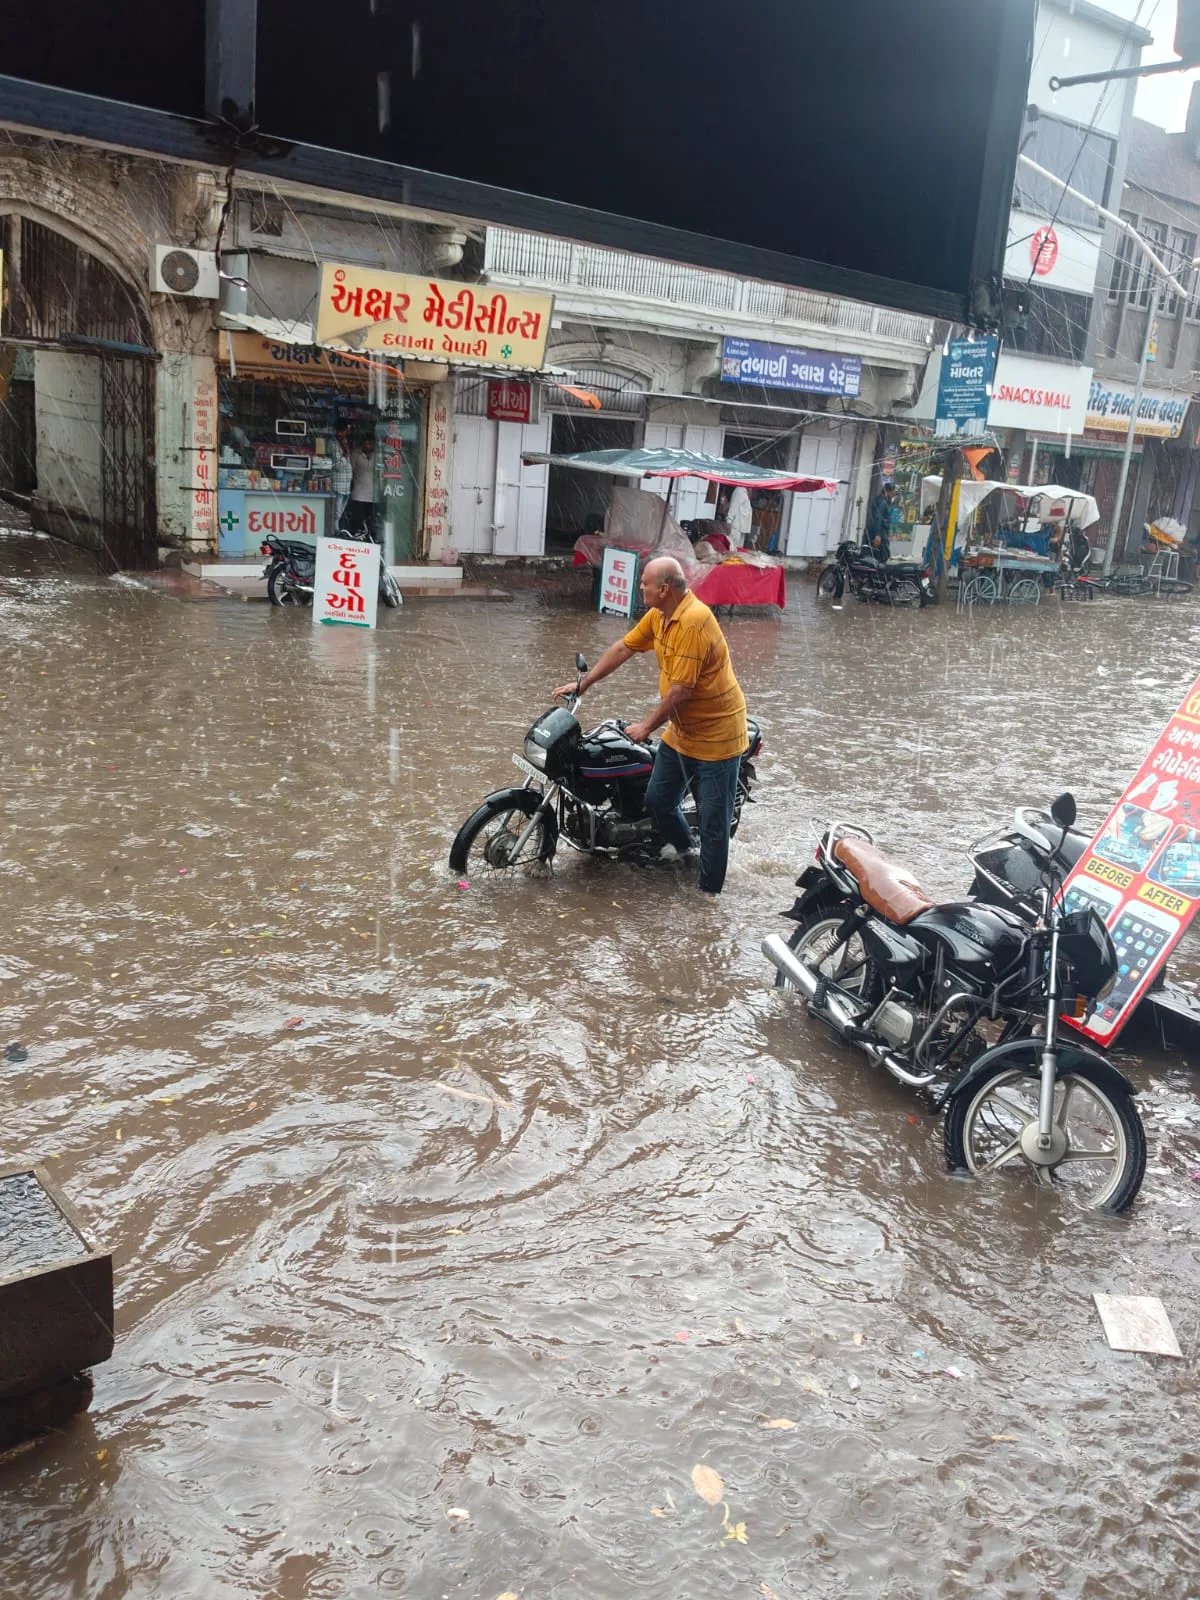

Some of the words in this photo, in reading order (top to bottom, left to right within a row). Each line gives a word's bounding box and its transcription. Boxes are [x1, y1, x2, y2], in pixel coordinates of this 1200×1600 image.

[331, 284, 411, 324] અક્ષર
[423, 283, 541, 340] મેડીસીન્સ
[383, 333, 434, 351] દવાના
[442, 334, 488, 357] વેપારી
[741, 355, 787, 378] તબાણી
[791, 363, 824, 383] ગ્લાસ
[829, 362, 845, 386] વેર
[490, 385, 527, 411] દવાઓ
[1000, 385, 1043, 407] SNACKS
[1044, 391, 1071, 410] MALL
[383, 484, 405, 497] A/C
[248, 505, 316, 534] દવાઓ
[1087, 859, 1132, 887] BEFORE
[1145, 887, 1184, 912] AFTER
